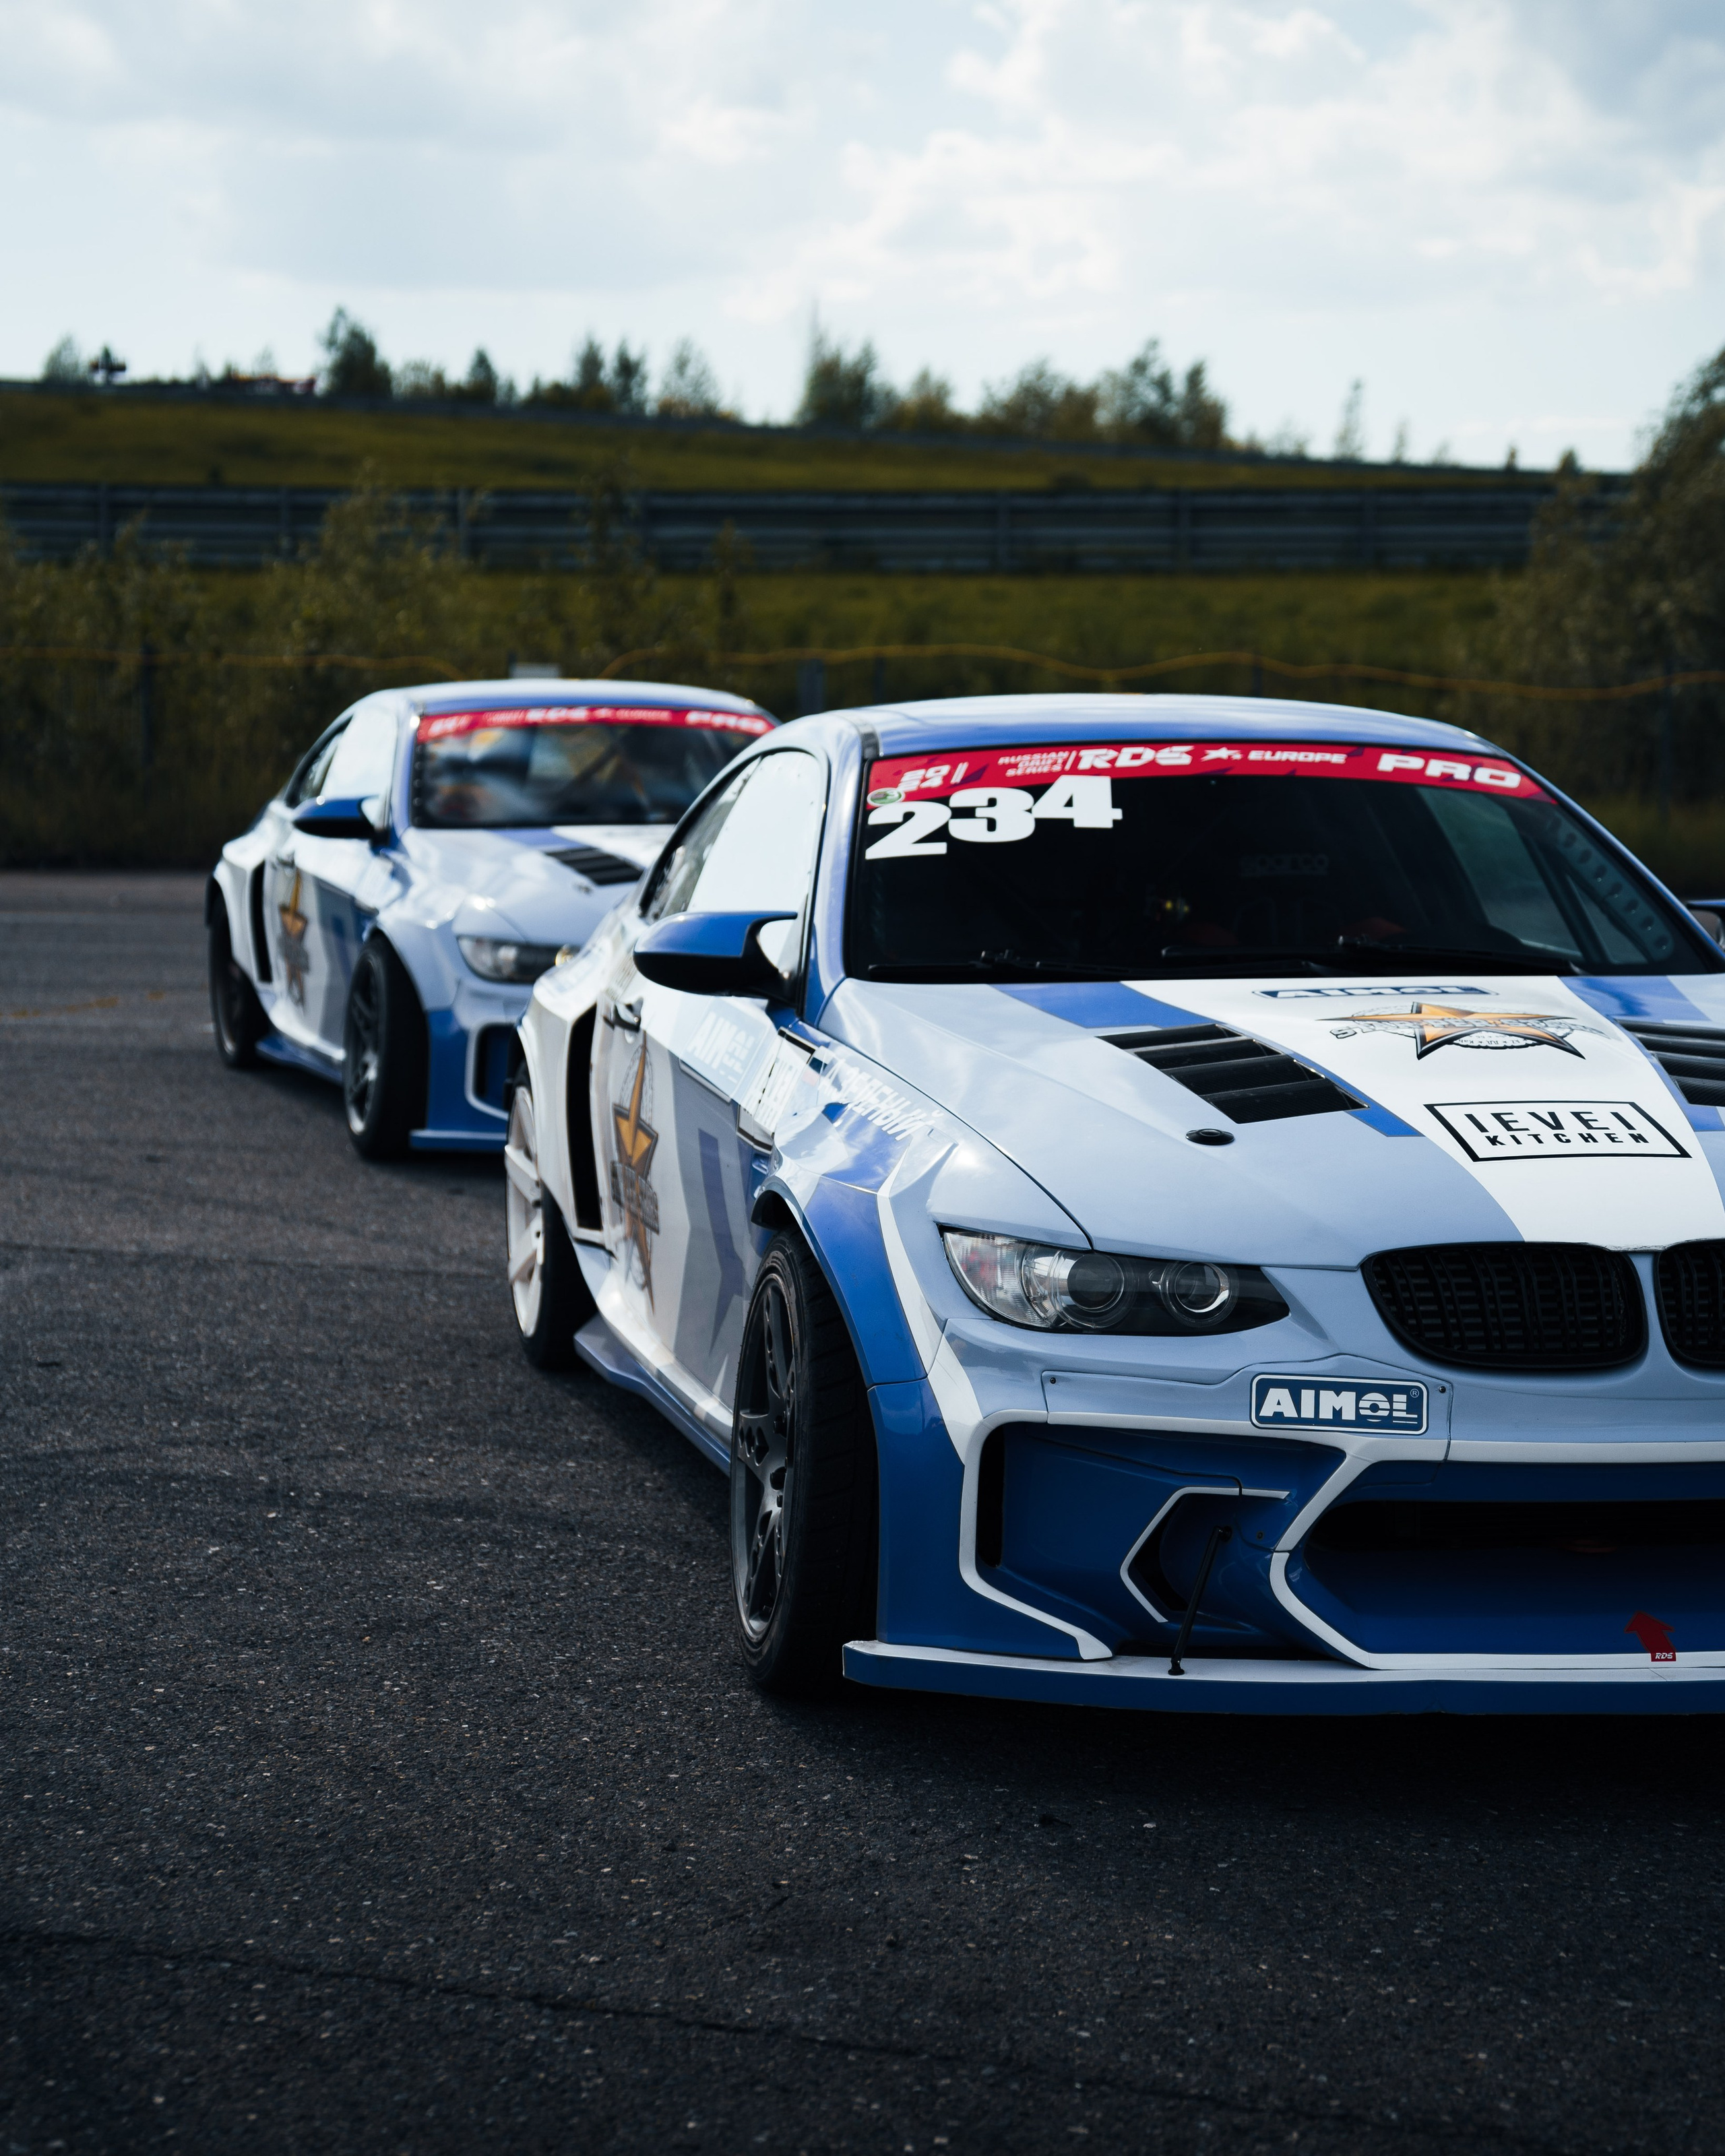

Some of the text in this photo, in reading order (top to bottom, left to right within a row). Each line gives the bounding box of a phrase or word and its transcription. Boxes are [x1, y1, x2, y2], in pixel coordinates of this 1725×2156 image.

[1077, 745, 1522, 789] RDS EUROPE PRO
[865, 774, 1123, 860] 234
[1276, 986, 1469, 998] AIMOL
[1484, 1133, 1650, 1146] KITCHEN
[1259, 1387, 1418, 1424] AIMOL
